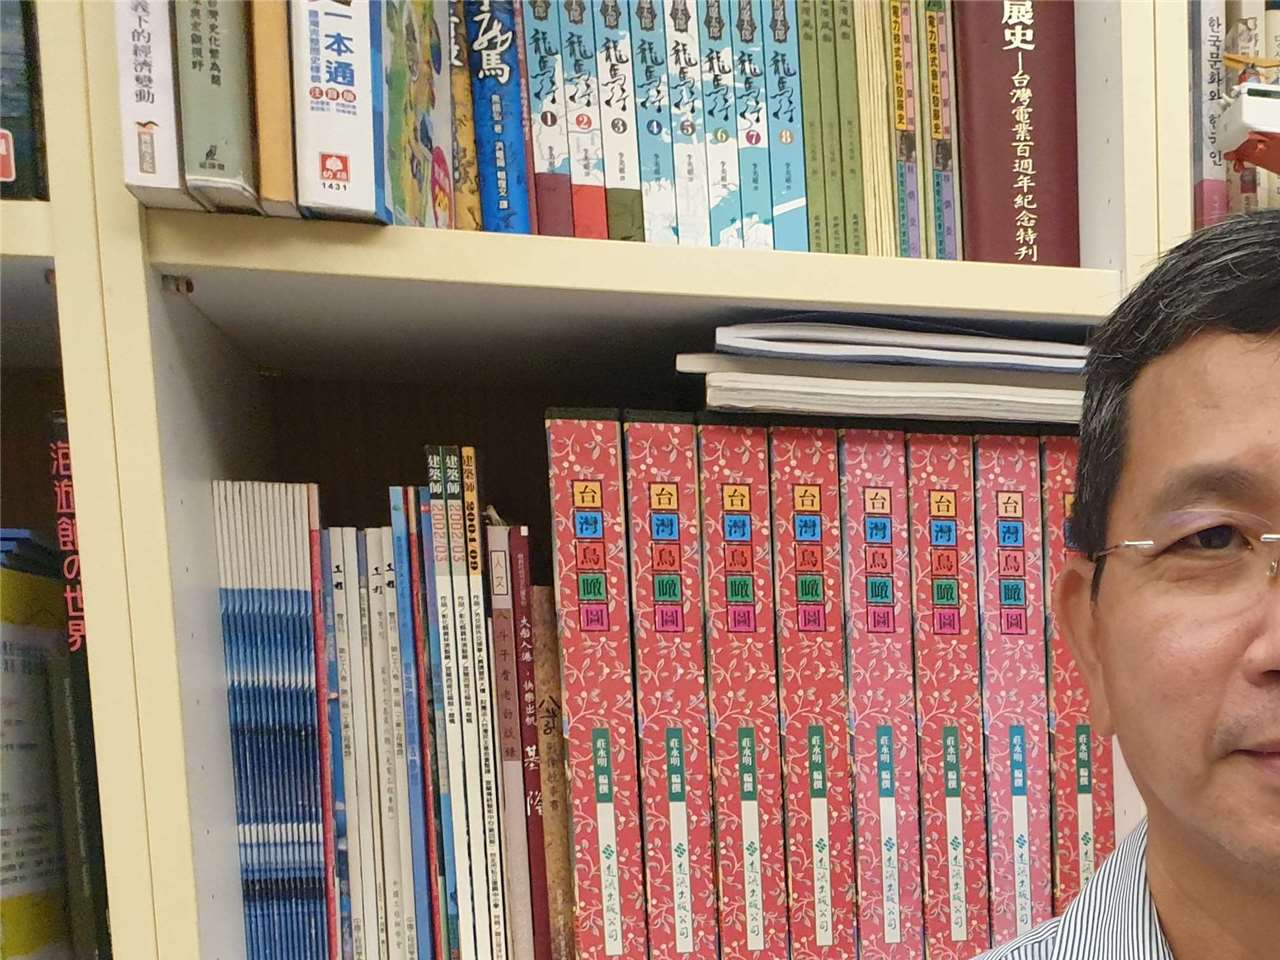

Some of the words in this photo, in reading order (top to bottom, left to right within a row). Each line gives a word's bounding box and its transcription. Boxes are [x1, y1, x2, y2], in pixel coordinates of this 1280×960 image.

[323, 11, 355, 88] 一本通
[529, 28, 558, 104] 龍馬行
[564, 32, 593, 107] 龍馬行
[600, 36, 629, 112] 龍馬行
[636, 38, 665, 113] 龍馬行
[670, 40, 698, 114] 龍馬行
[704, 48, 732, 122] 龍馬行
[737, 50, 763, 123] 龍馬行
[769, 50, 797, 123] 龍馬行
[542, 112, 556, 126] 1
[576, 114, 591, 129] 2
[612, 119, 626, 133] 3
[647, 120, 661, 134] 4
[681, 121, 695, 135] 5
[714, 128, 728, 142] 6
[746, 131, 760, 145] 7
[779, 130, 793, 144] 8
[321, 182, 347, 192] 1431
[428, 455, 442, 495] 建築師
[446, 455, 460, 495] 建築師
[578, 485, 604, 627] 台灣鳥瞰圖
[655, 487, 679, 627] 台灣鳥瞰圖
[727, 488, 751, 627] 台灣鳥瞰圖
[798, 489, 821, 627] 台灣鳥瞰圖
[868, 491, 891, 629] 台灣鳥瞰圖
[933, 494, 956, 630] 台灣鳥瞰圖
[1001, 496, 1023, 630] 台灣鳥瞰圖
